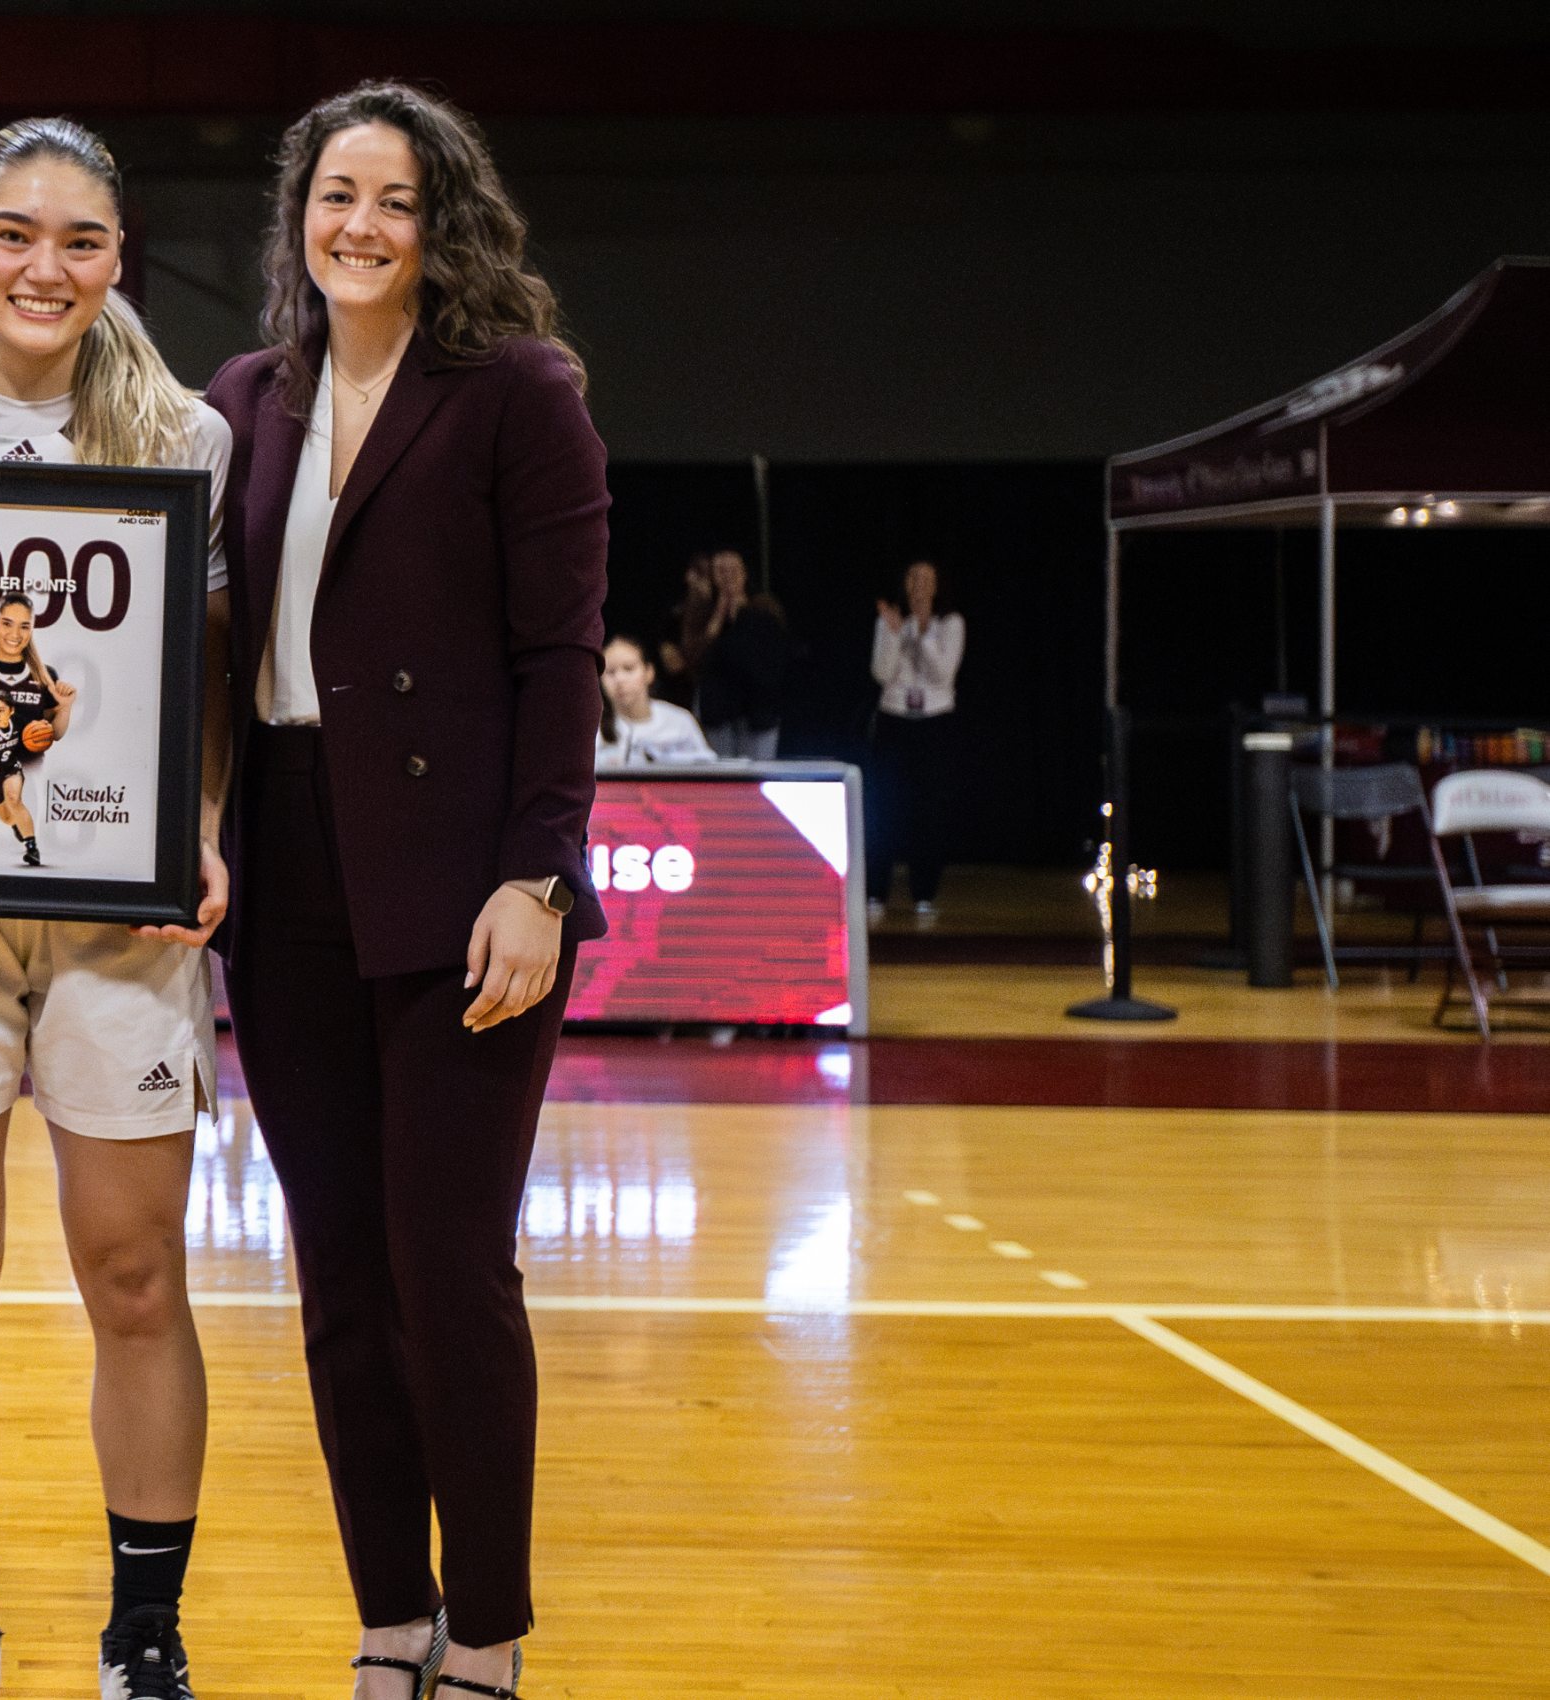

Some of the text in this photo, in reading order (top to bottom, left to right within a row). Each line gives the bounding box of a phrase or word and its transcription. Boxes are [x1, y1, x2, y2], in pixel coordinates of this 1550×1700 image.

[138, 518, 161, 526] GREY
[22, 578, 77, 593] POINTS
[52, 783, 126, 804] Natsuki
[51, 802, 130, 824] Szczokin
[138, 1079, 180, 1091] adidas
